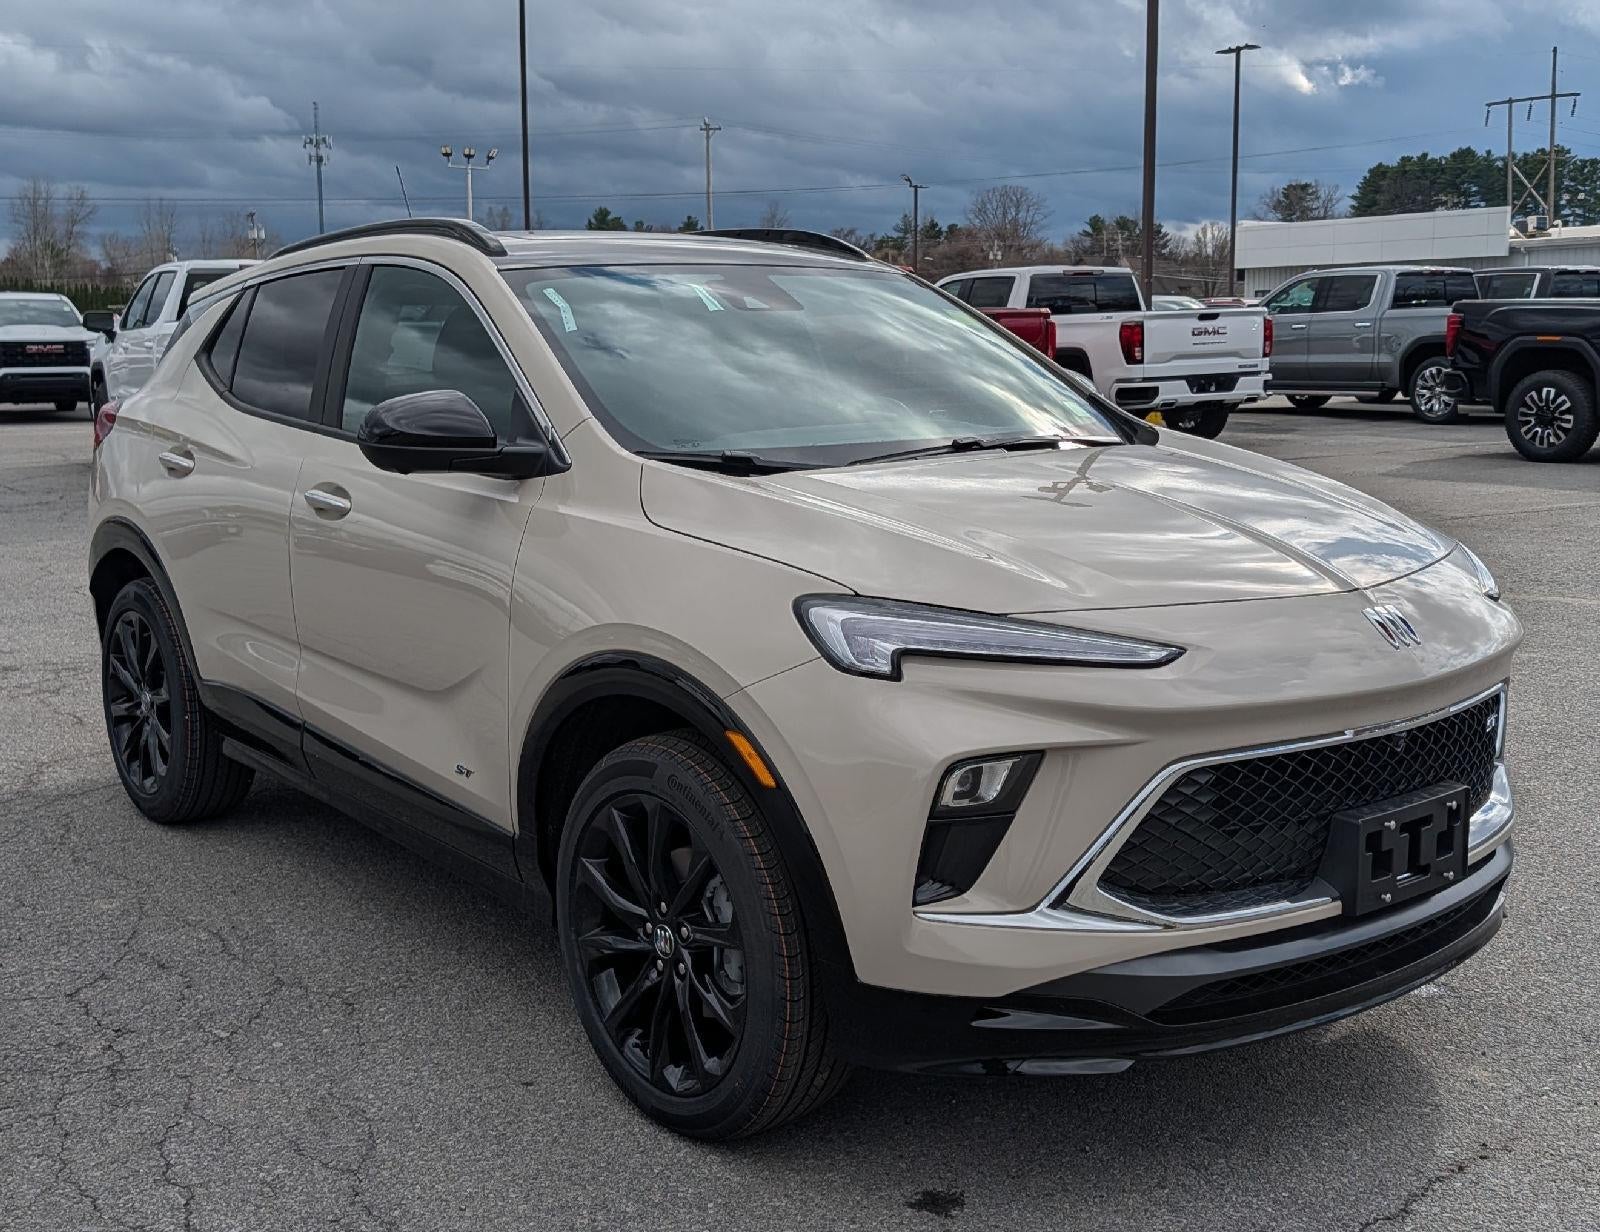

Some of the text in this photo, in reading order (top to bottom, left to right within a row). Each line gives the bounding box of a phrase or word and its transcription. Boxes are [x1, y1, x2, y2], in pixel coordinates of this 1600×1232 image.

[1192, 327, 1228, 337] GMC
[455, 764, 475, 779] ST
[667, 774, 721, 832] Continental
